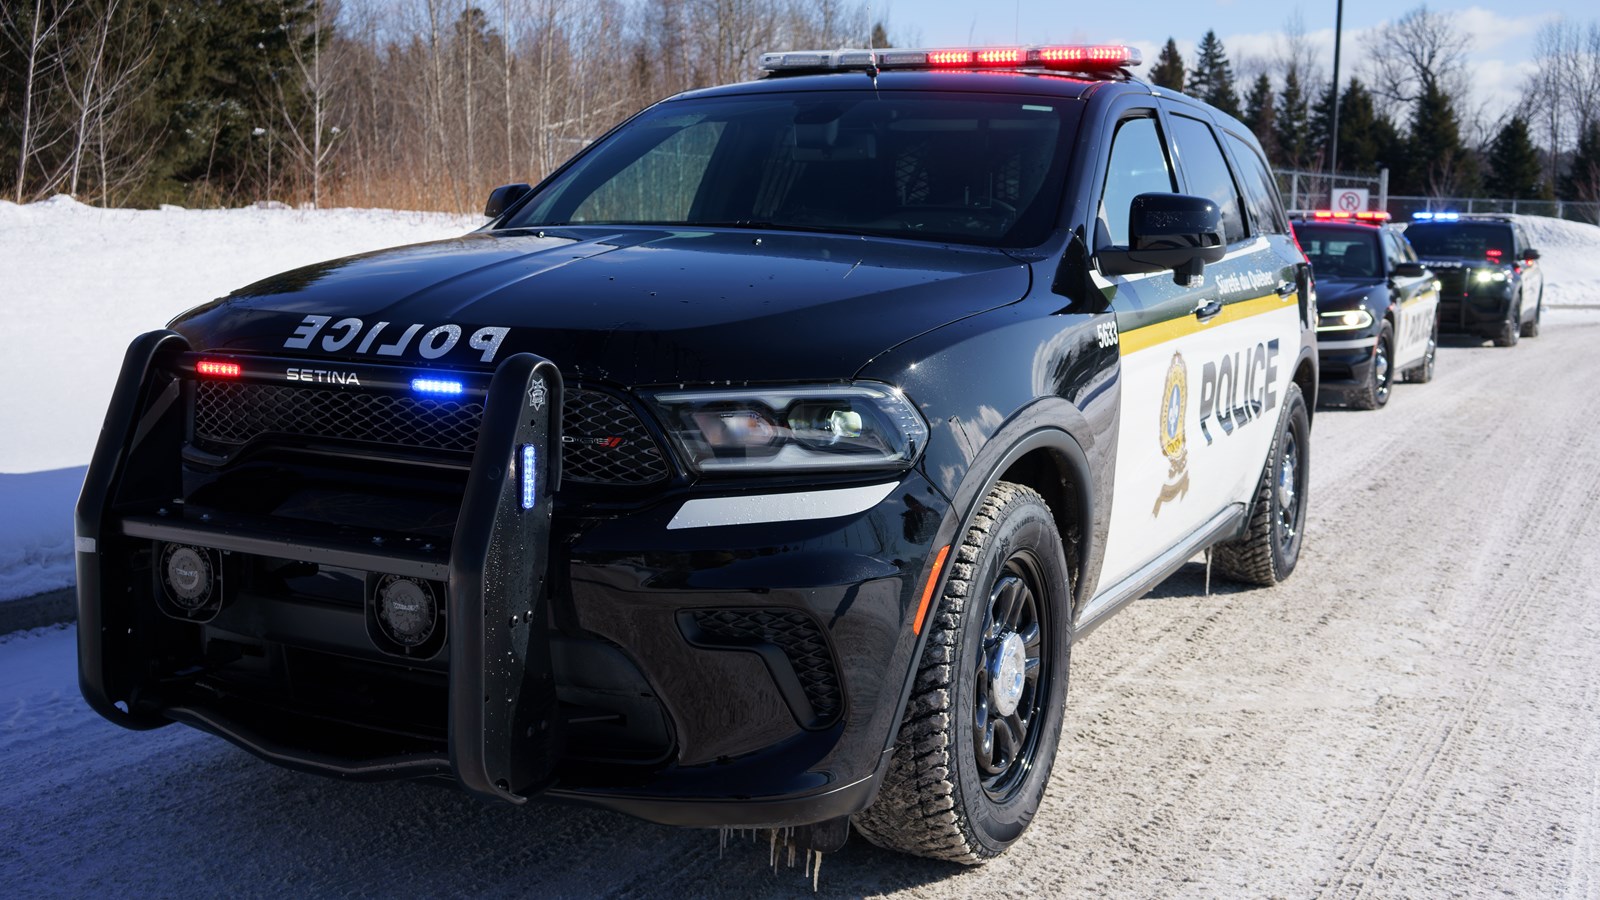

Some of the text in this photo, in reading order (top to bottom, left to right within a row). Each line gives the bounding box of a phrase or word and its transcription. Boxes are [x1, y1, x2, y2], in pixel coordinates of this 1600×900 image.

[1239, 272, 1252, 290] du
[1097, 321, 1118, 348] 5633
[286, 368, 360, 385] SETINA
[1200, 338, 1279, 446] POLICE
